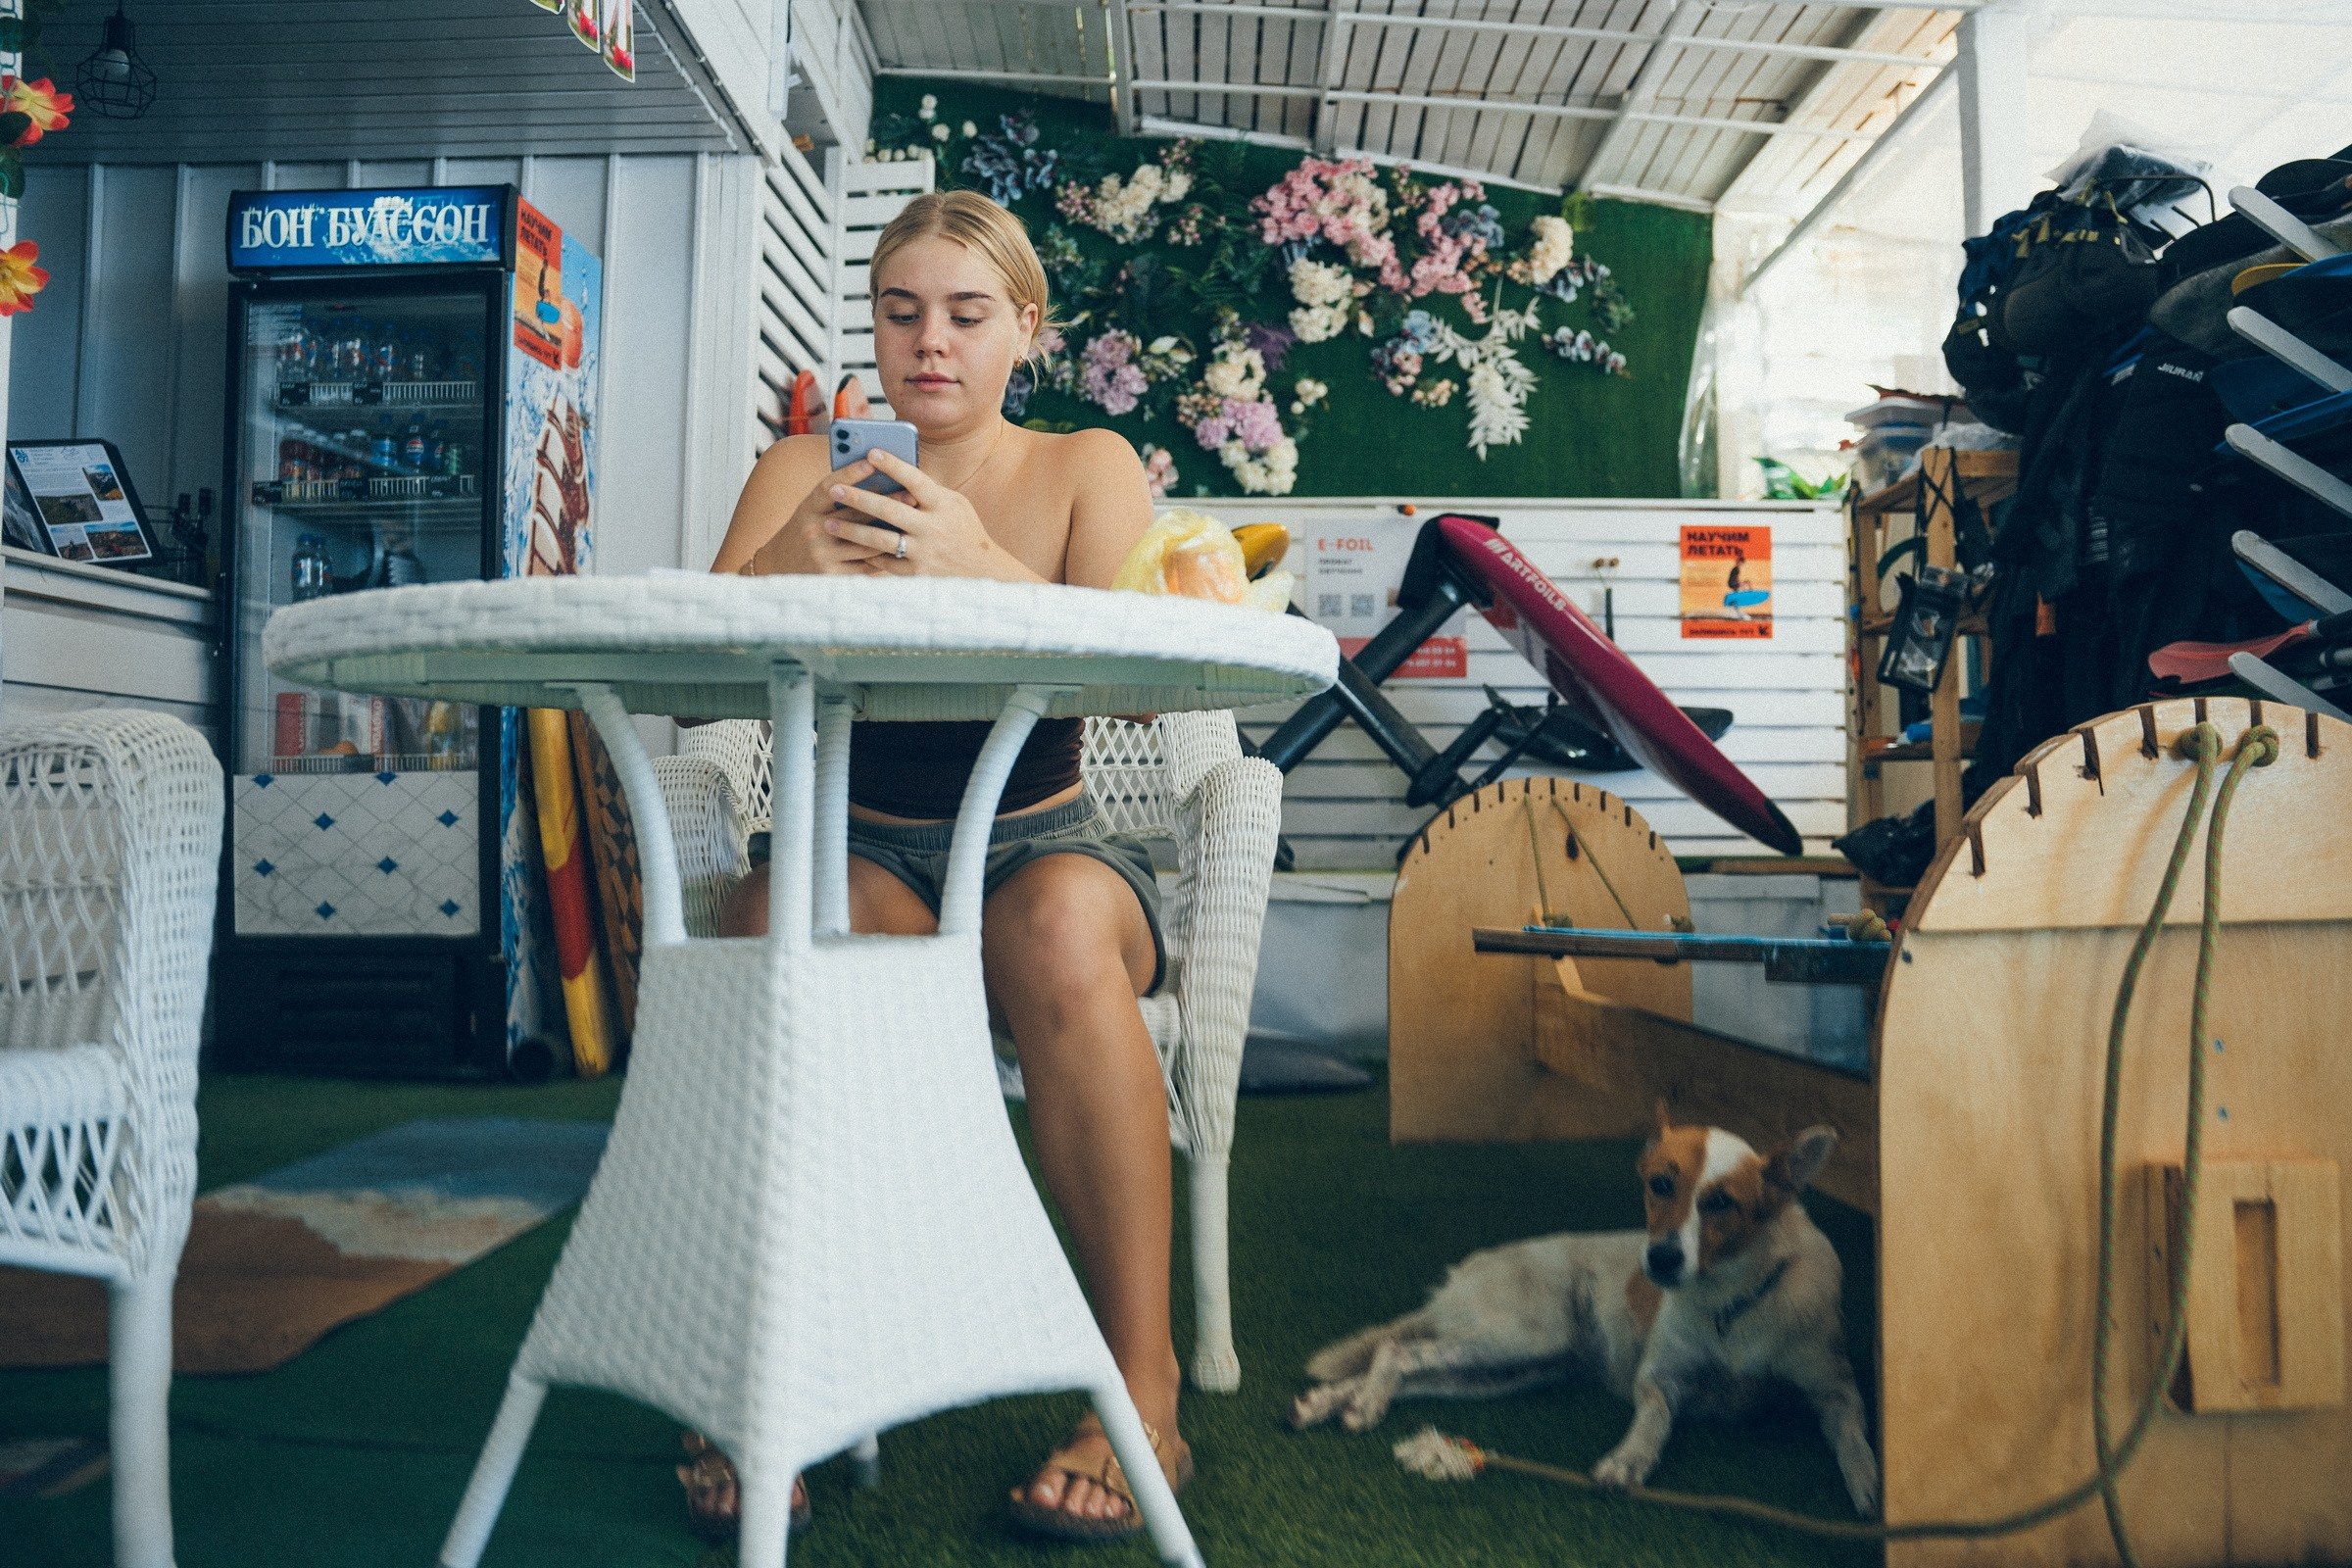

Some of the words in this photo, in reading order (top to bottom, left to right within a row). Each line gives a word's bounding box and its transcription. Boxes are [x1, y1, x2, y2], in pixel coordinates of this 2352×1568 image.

[240, 206, 315, 248] БОН
[1317, 537, 1374, 551] E-FOIL
[1687, 532, 1749, 542] НАУЧИМ
[1688, 545, 1743, 557] ЛЕТАТЬ
[1499, 551, 1567, 612] ARTFOILS
